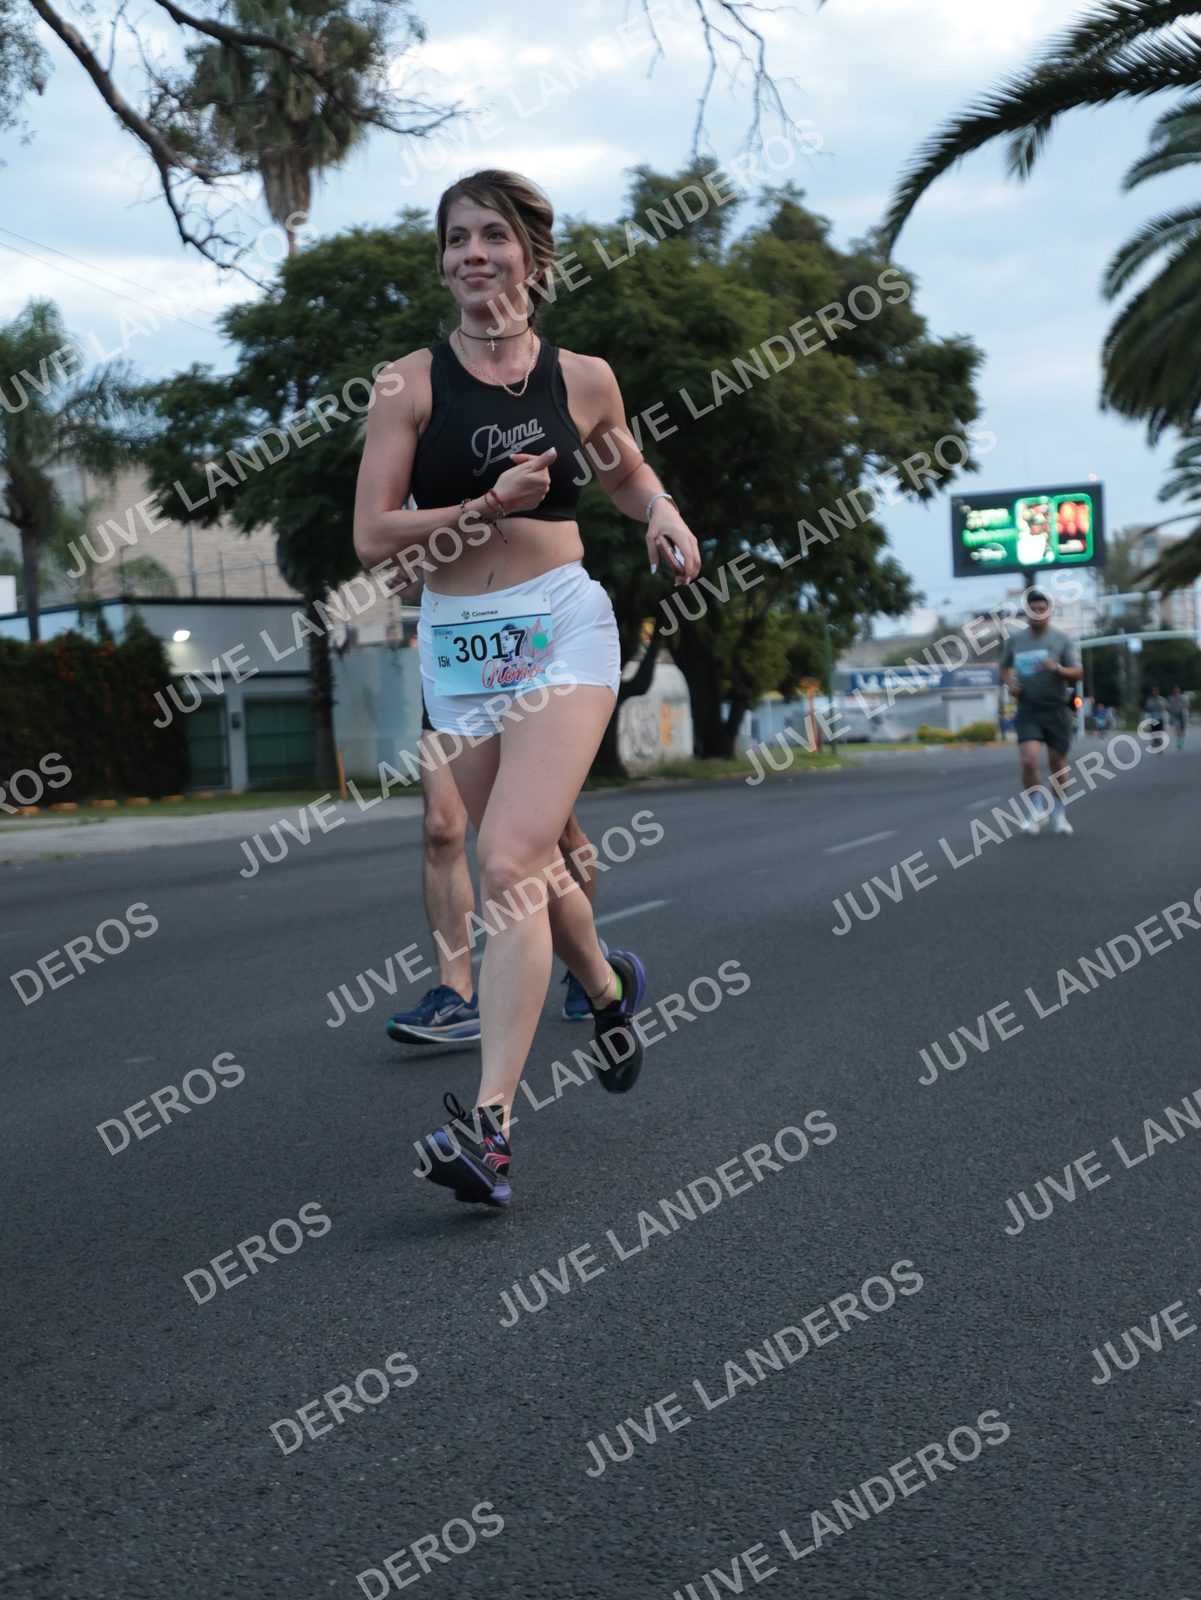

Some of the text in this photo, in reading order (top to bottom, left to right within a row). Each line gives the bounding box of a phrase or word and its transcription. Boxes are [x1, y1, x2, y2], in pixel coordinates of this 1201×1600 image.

[471, 418, 544, 477] Puma
[471, 608, 499, 618] Cinemex
[452, 629, 526, 663] 3017
